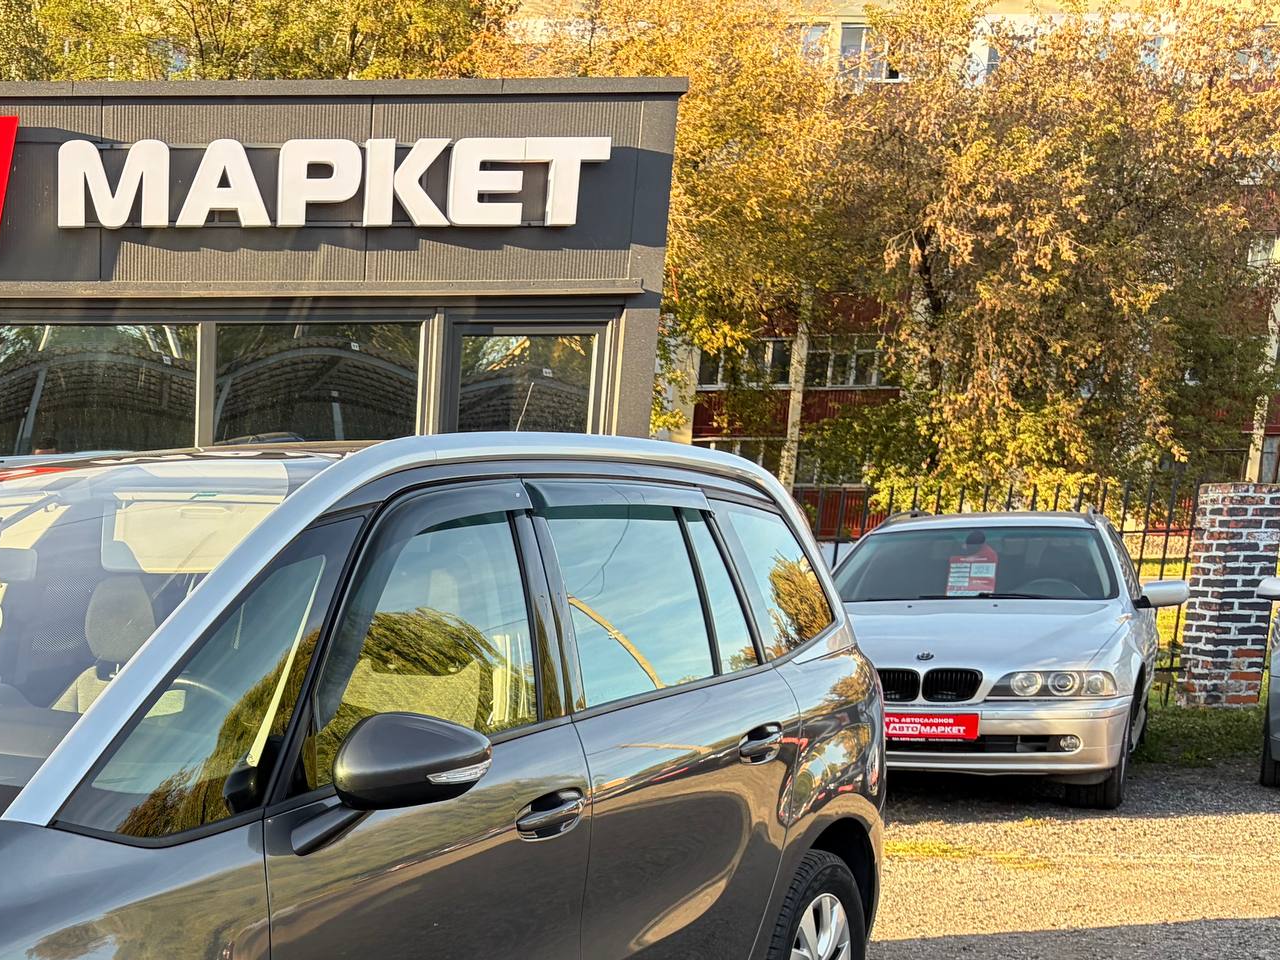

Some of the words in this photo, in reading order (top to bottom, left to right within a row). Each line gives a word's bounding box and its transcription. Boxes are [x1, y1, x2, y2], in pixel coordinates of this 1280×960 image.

[57, 136, 612, 228] МАРКЕТ
[890, 725, 919, 733] АВТО
[920, 726, 966, 734] МАРКЕТ
